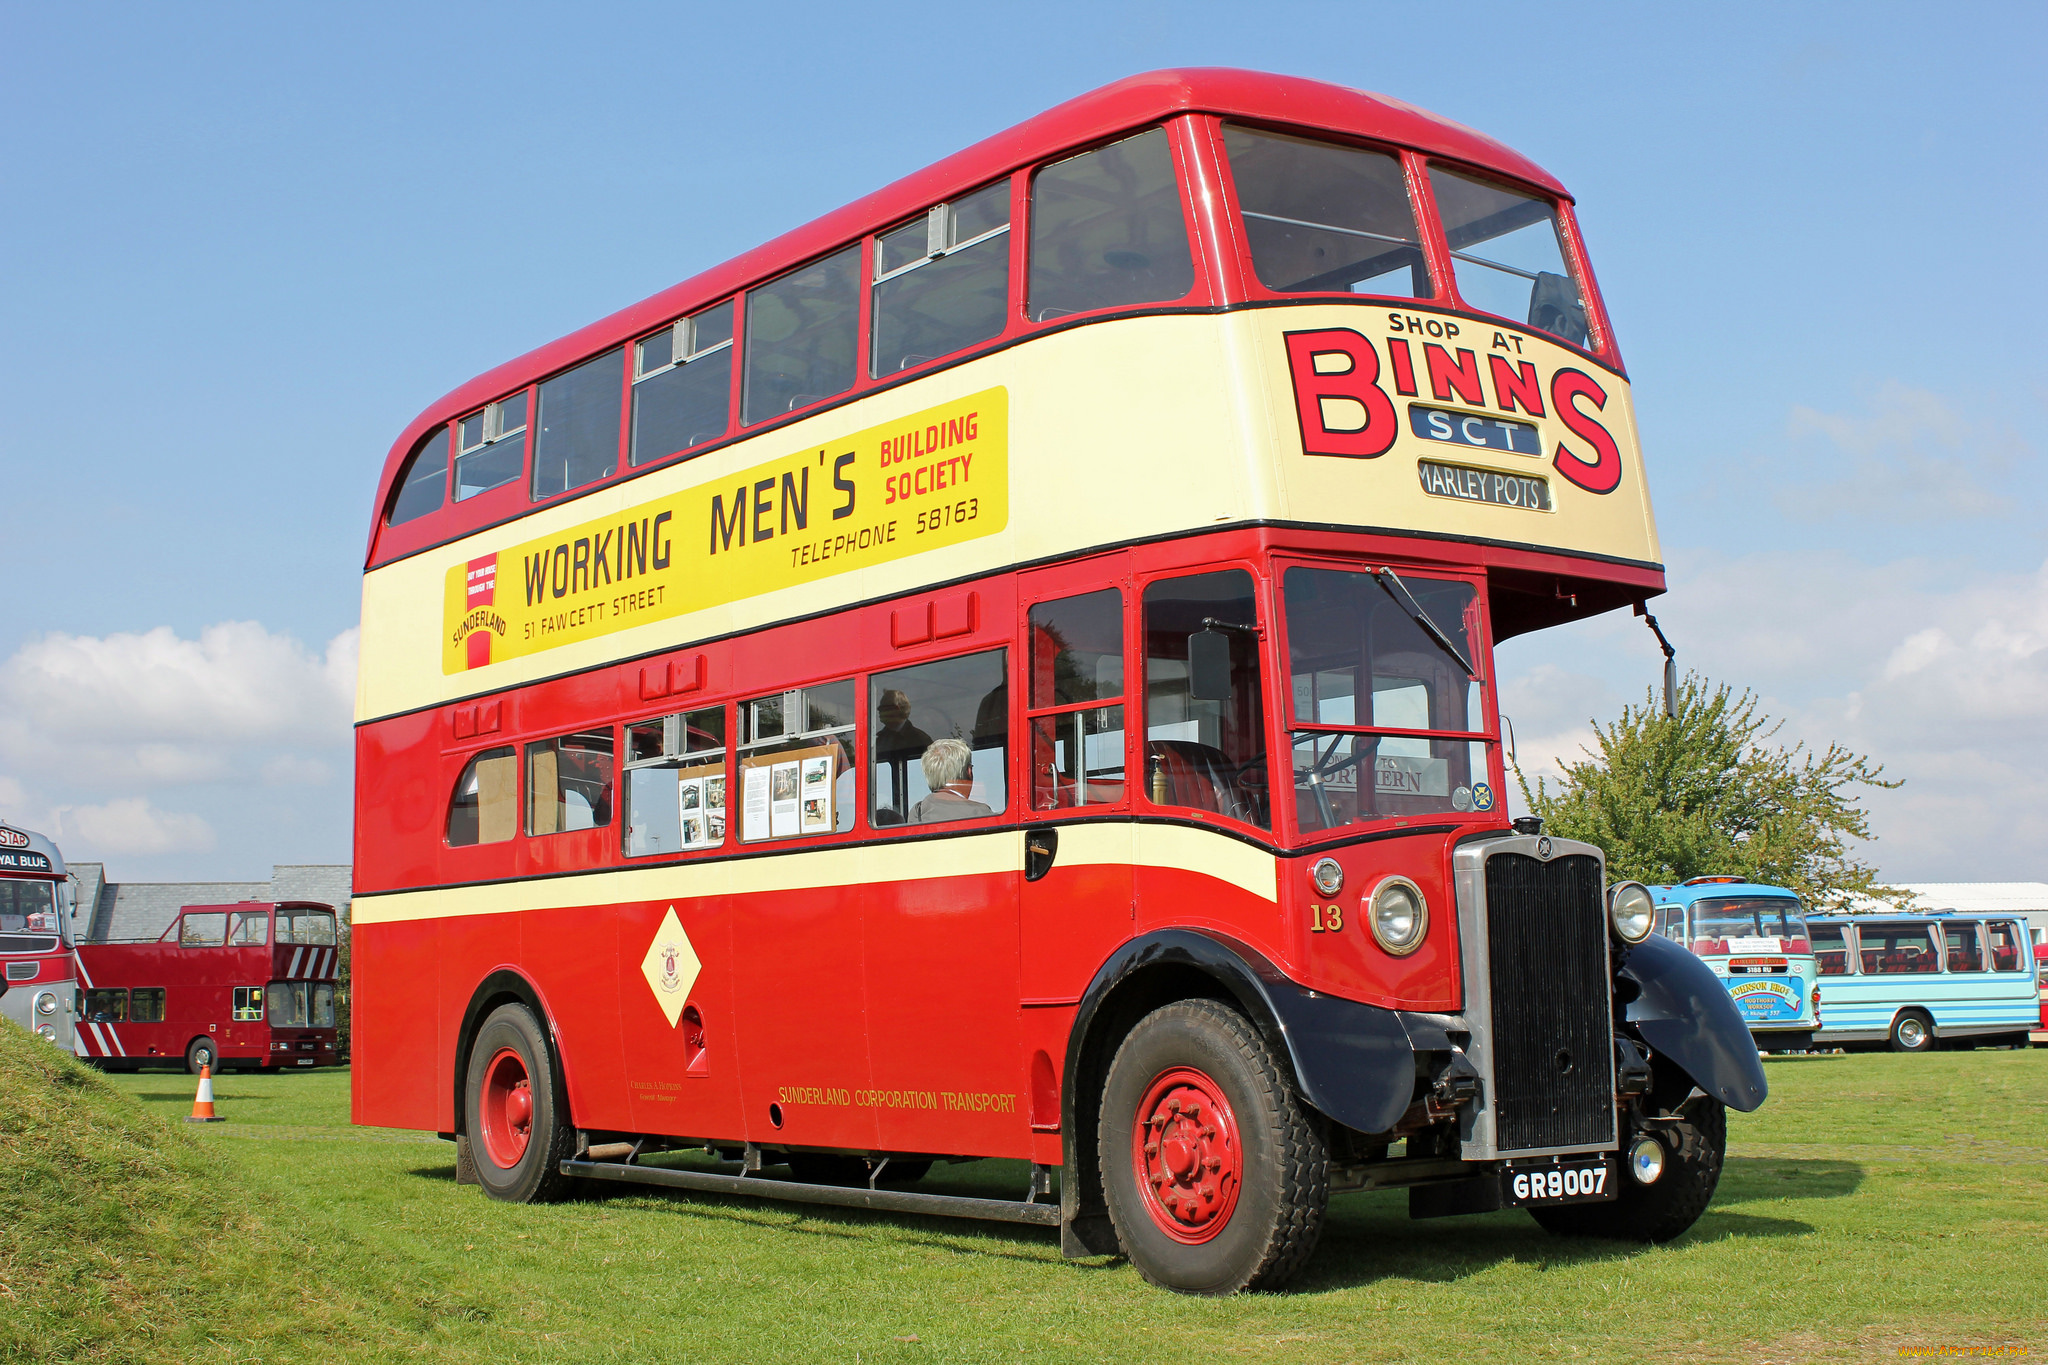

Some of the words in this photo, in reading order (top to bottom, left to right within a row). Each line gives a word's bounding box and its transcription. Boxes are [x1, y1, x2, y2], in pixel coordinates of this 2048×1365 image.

[1388, 312, 1460, 340] SHOP
[1492, 331, 1524, 355] AT
[1282, 327, 1622, 496] BINNS
[880, 411, 978, 468] BUILDING
[885, 453, 973, 505] SOCIETY
[1494, 473, 1540, 510] POTS
[524, 510, 672, 607] WORKING
[710, 450, 856, 556] MEN'S
[792, 520, 897, 568] TELEPHONE
[916, 498, 978, 535] 58163
[453, 610, 507, 648] SUNDERLAND
[524, 622, 536, 640] 51
[542, 603, 605, 635] FAWCETT
[613, 585, 666, 616] STREET
[20, 855, 48, 867] BLUE
[1310, 904, 1343, 933] 13
[1730, 982, 1767, 997] JOHNSON
[778, 1086, 851, 1107] SUNDERLAND
[854, 1089, 938, 1110] CORPORATION
[941, 1091, 1017, 1113] TRANSPORT
[1513, 1168, 1607, 1199] GR9007
